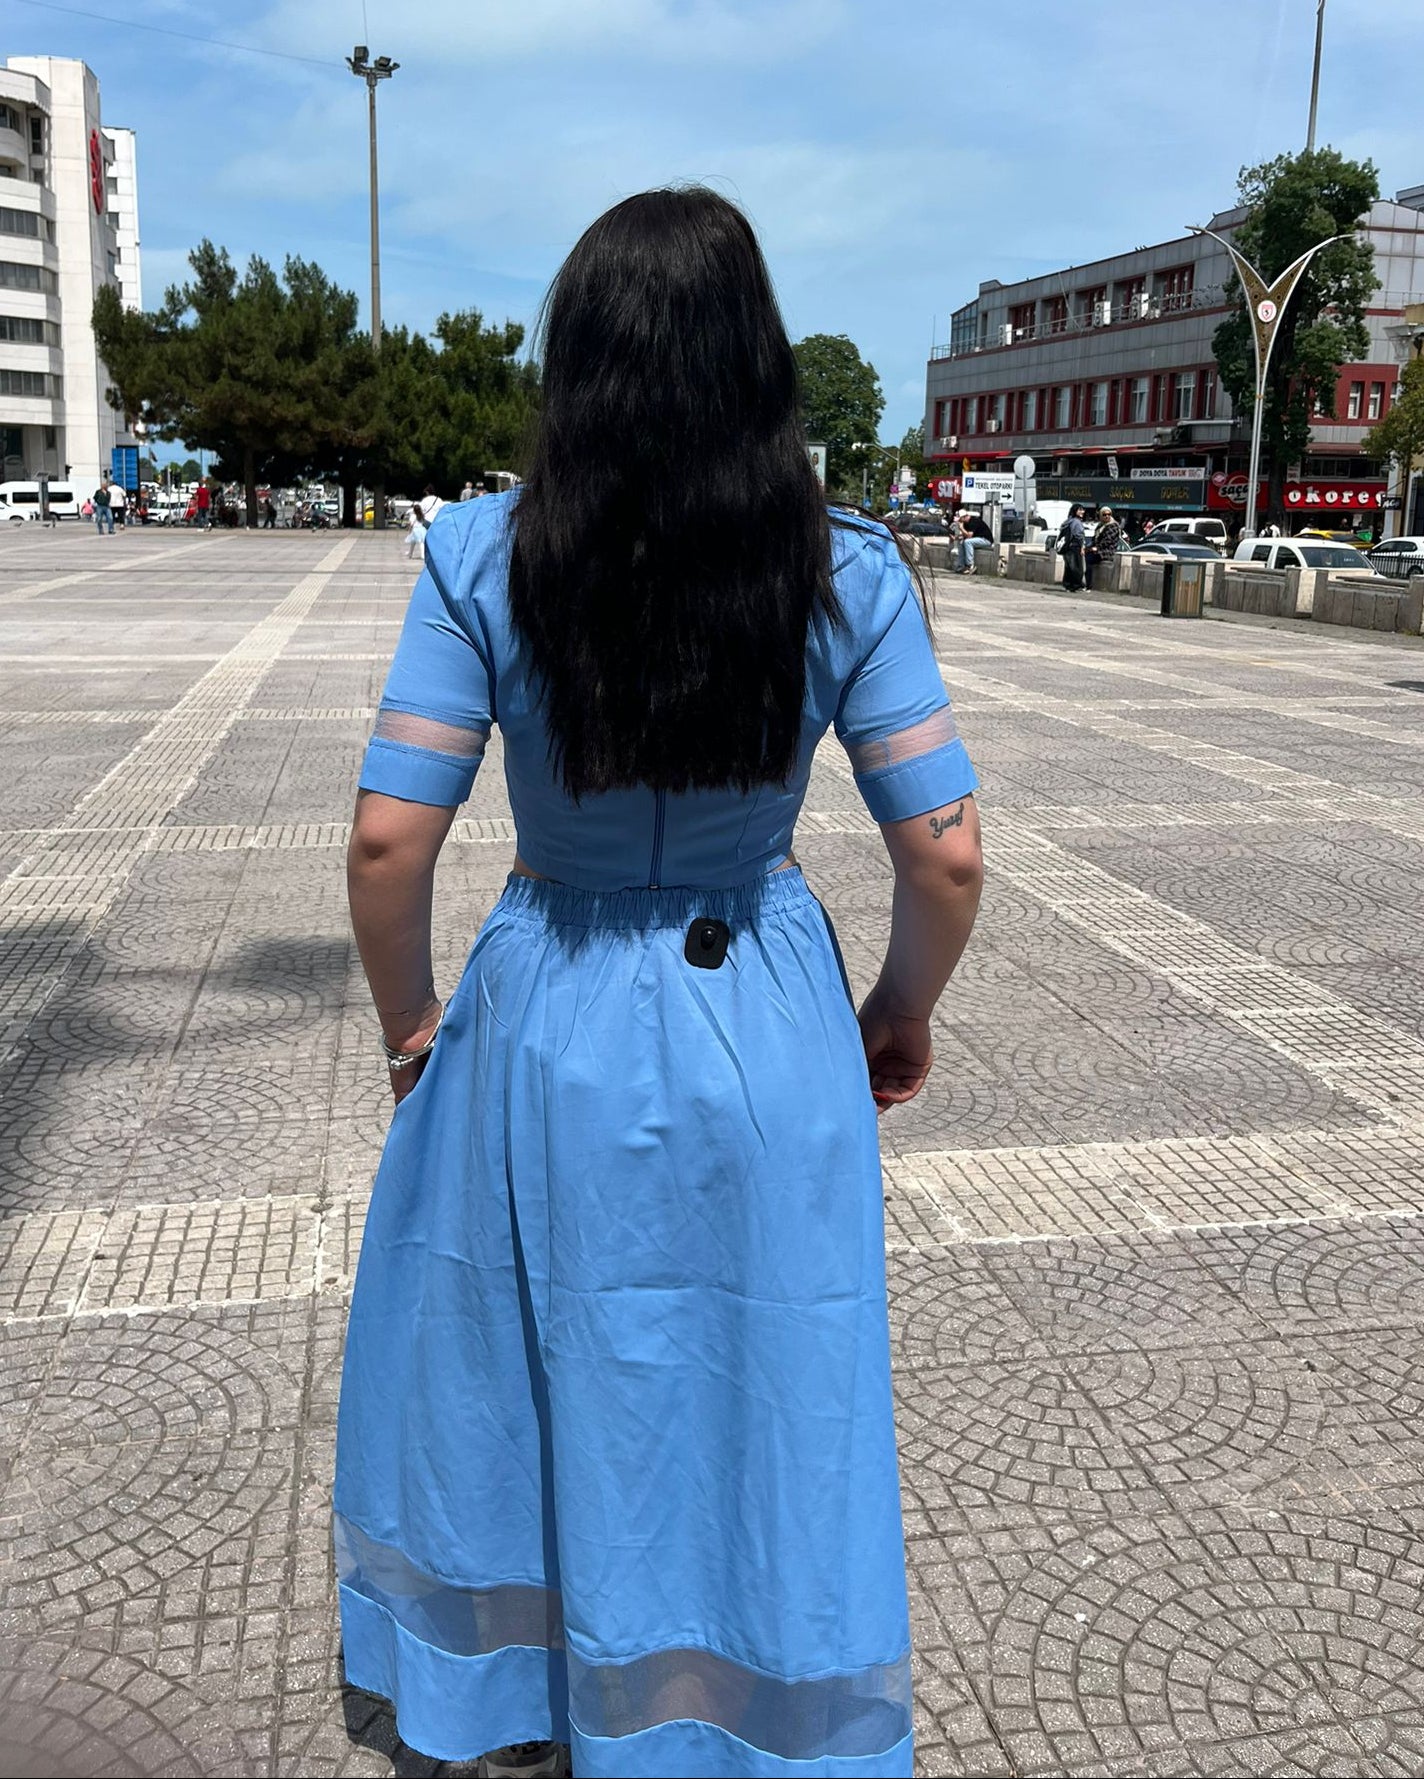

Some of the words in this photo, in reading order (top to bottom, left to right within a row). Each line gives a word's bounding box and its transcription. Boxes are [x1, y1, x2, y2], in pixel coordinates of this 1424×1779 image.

[975, 482, 989, 490] TEKEL
[1221, 483, 1259, 497] saça
[1288, 486, 1386, 507] okoreç
